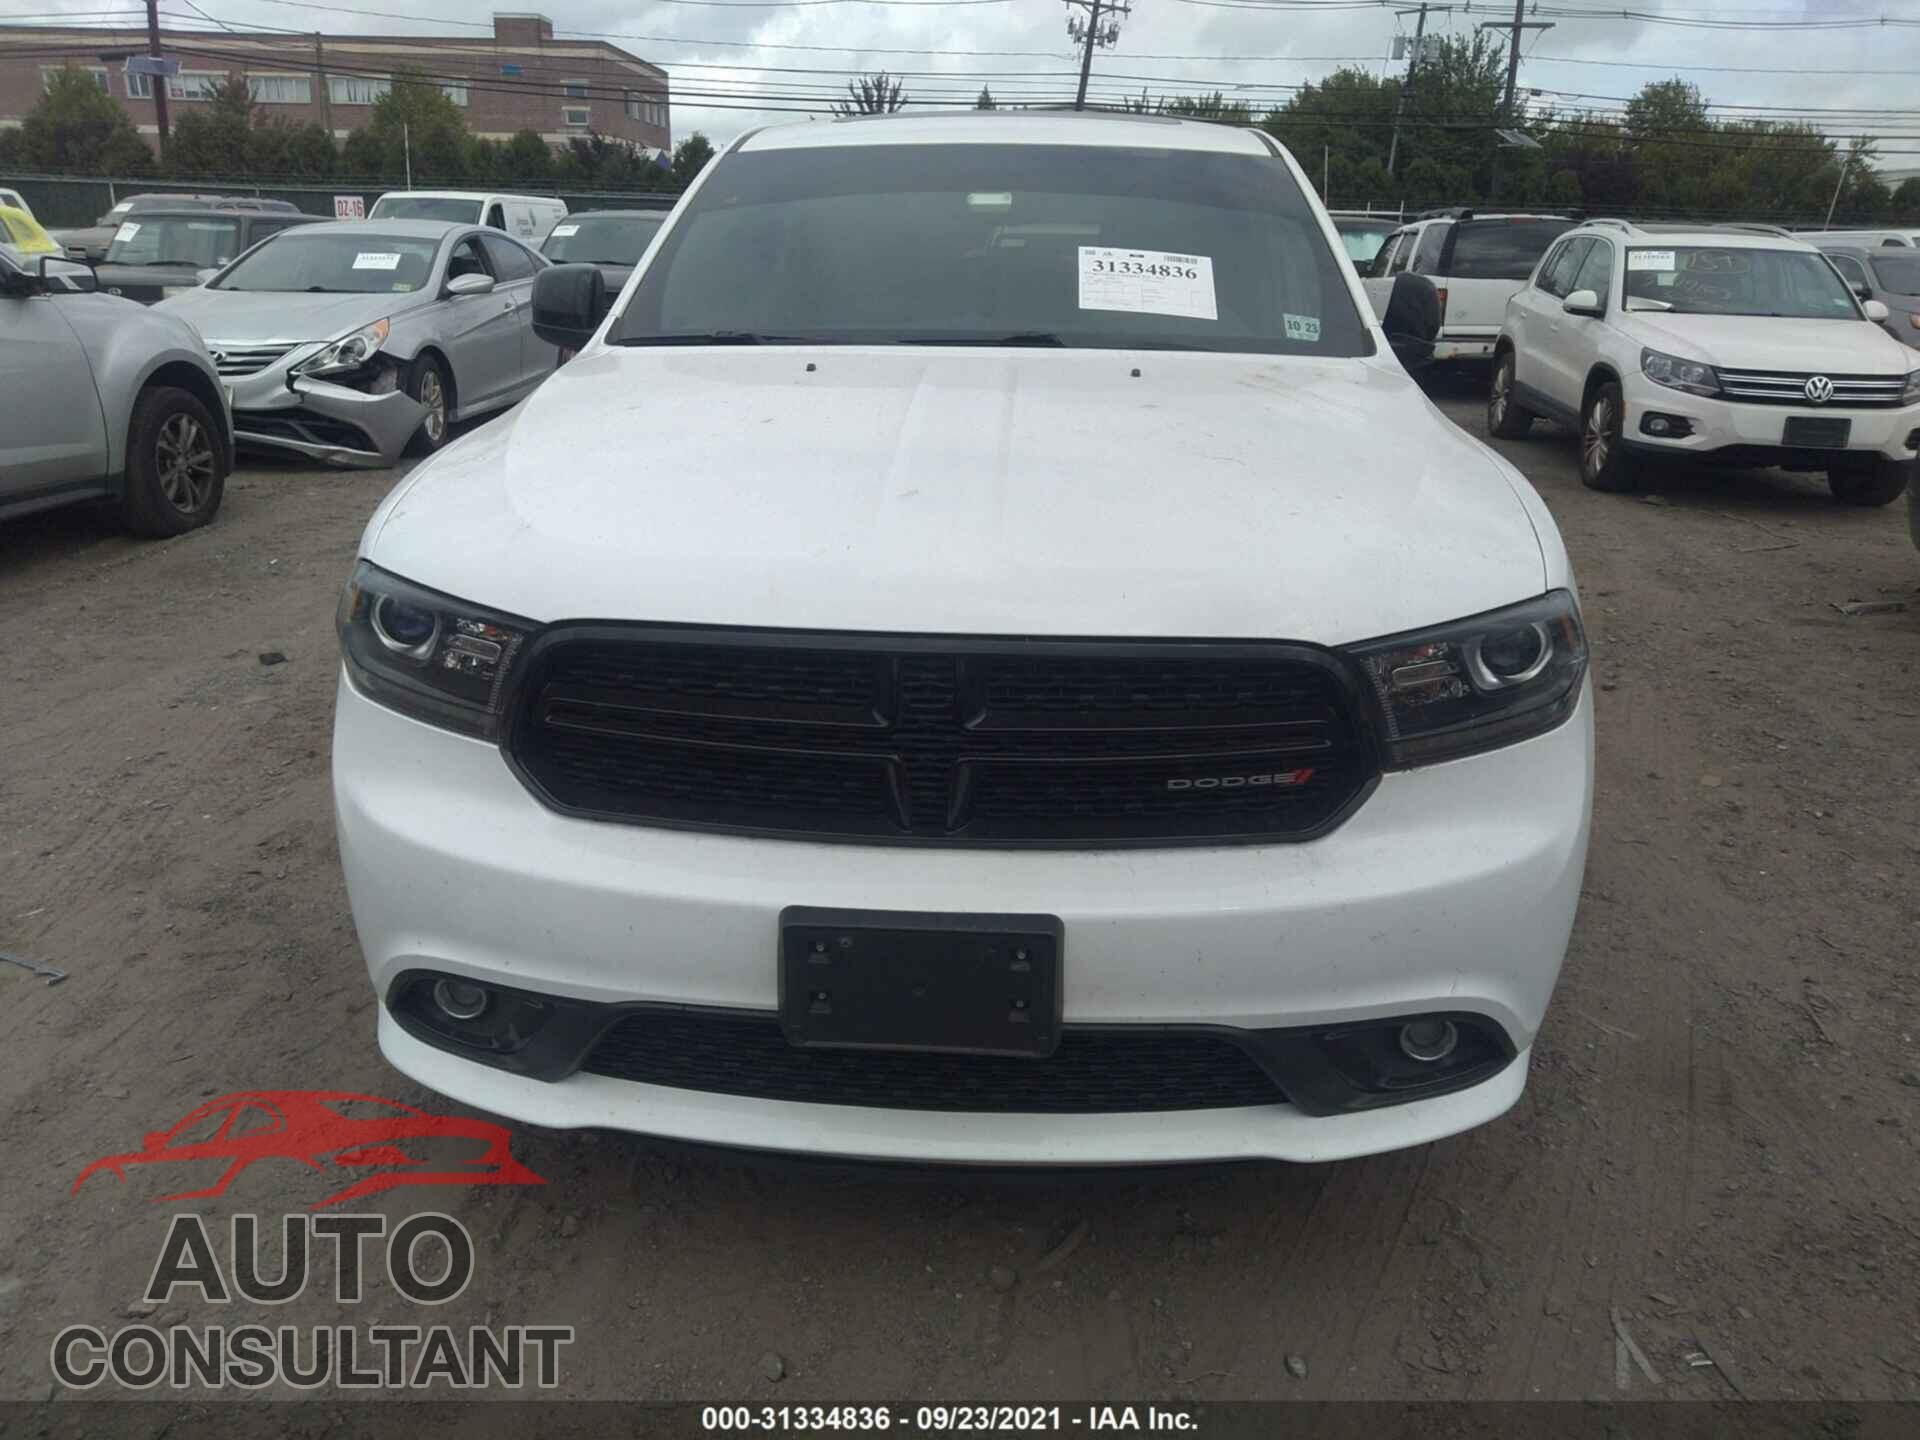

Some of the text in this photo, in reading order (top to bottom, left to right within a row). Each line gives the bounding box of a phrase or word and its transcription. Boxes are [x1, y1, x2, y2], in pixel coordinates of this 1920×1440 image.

[1092, 259, 1198, 280] 31334836
[1287, 320, 1301, 331] 10
[1167, 773, 1297, 789] DODGE
